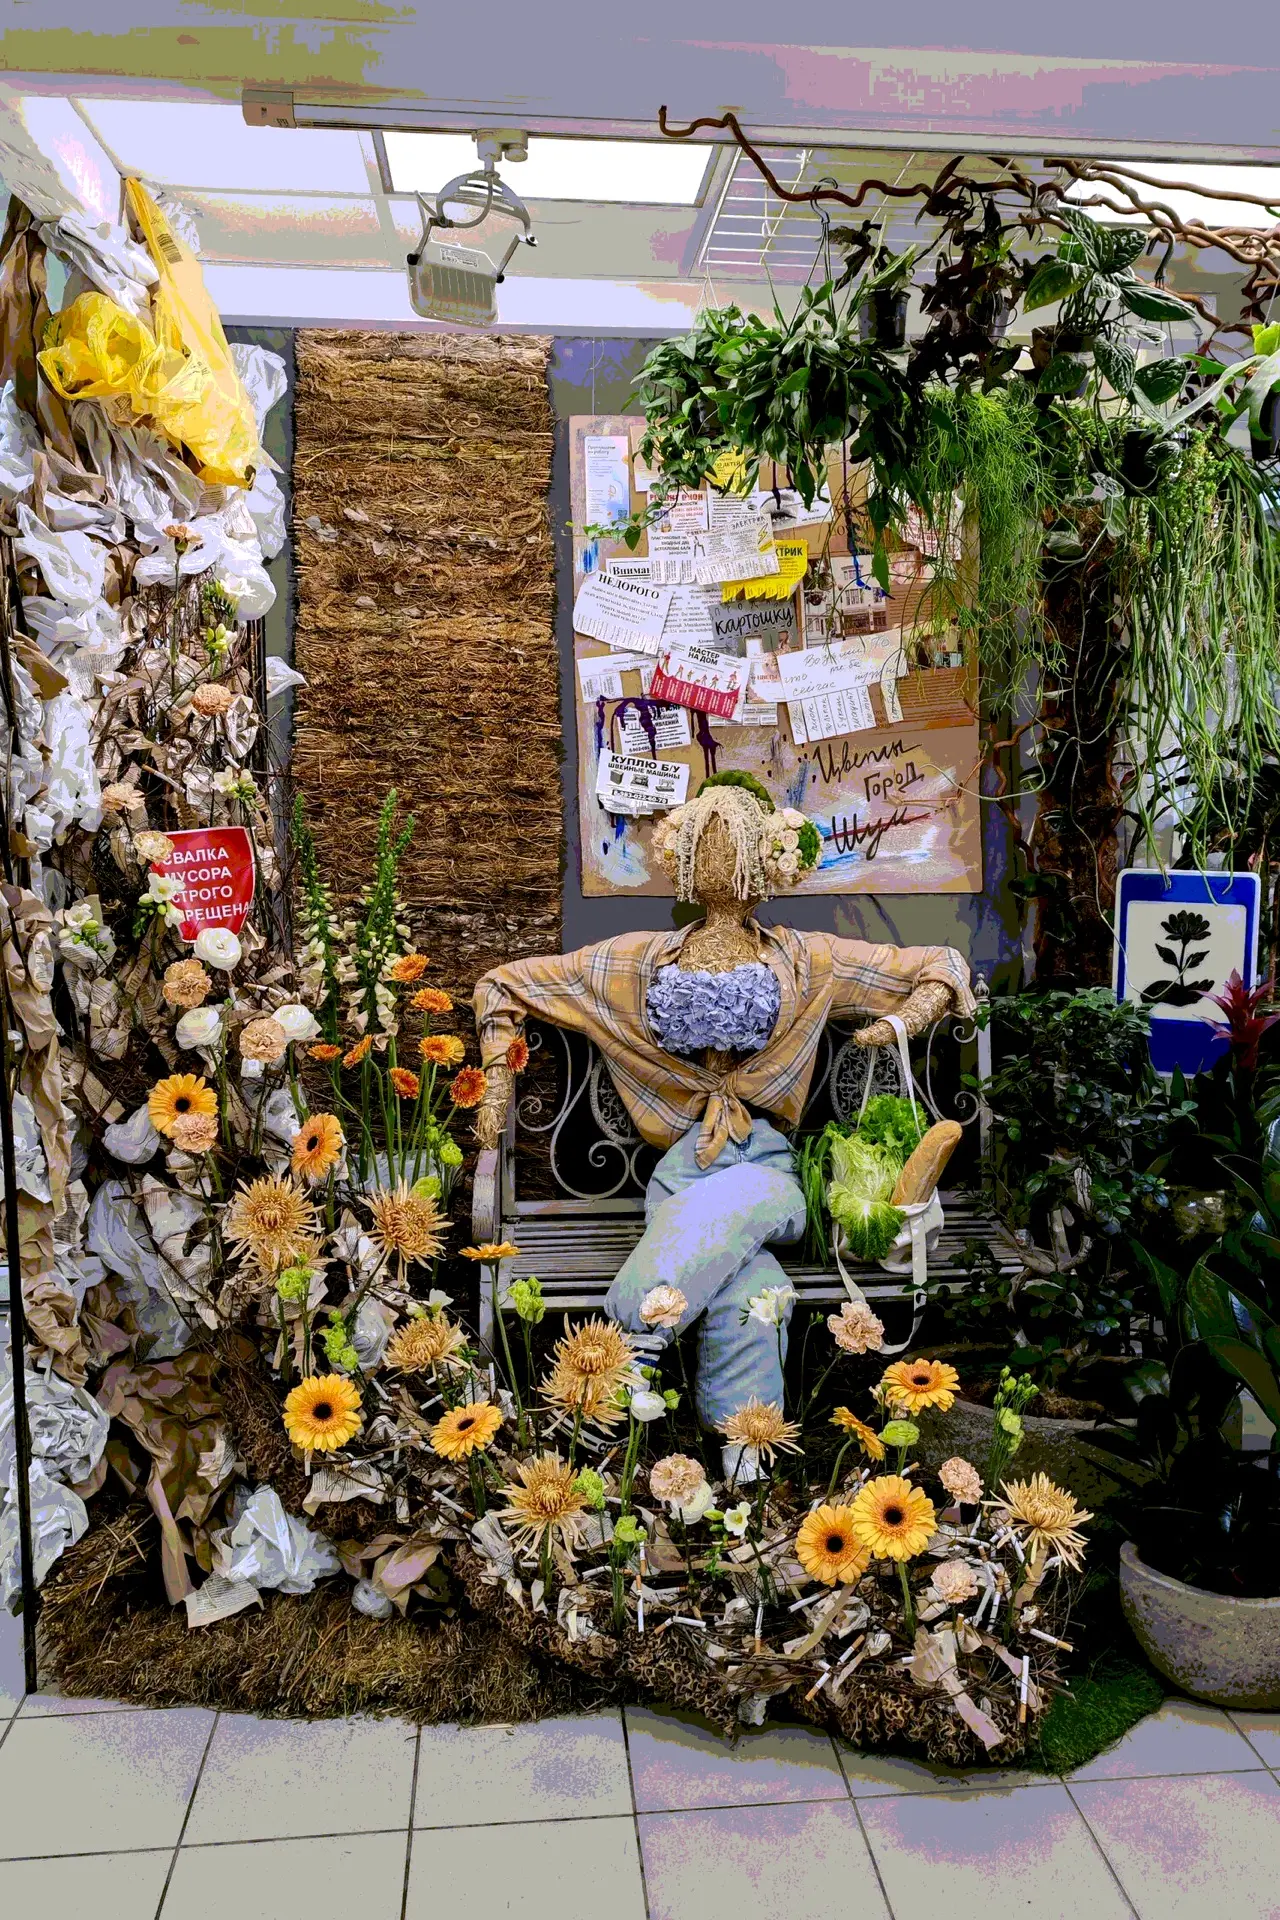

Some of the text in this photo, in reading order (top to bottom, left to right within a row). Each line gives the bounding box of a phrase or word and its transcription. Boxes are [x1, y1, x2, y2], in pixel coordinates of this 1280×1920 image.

[776, 546, 803, 557] КТРИК
[598, 573, 660, 599] НЕДОРОГО
[688, 651, 699, 660] НА
[700, 655, 718, 666] ДОМ
[689, 645, 720, 659] МАСТЕР
[611, 755, 681, 773] КУПЛЮ Б/У
[646, 768, 681, 780] МАШИНЫ
[162, 847, 230, 866] СВАЛКА
[163, 866, 232, 883] МУСОРА
[171, 885, 233, 903] СТРОГО
[185, 901, 250, 922] РЕЩЕНА
